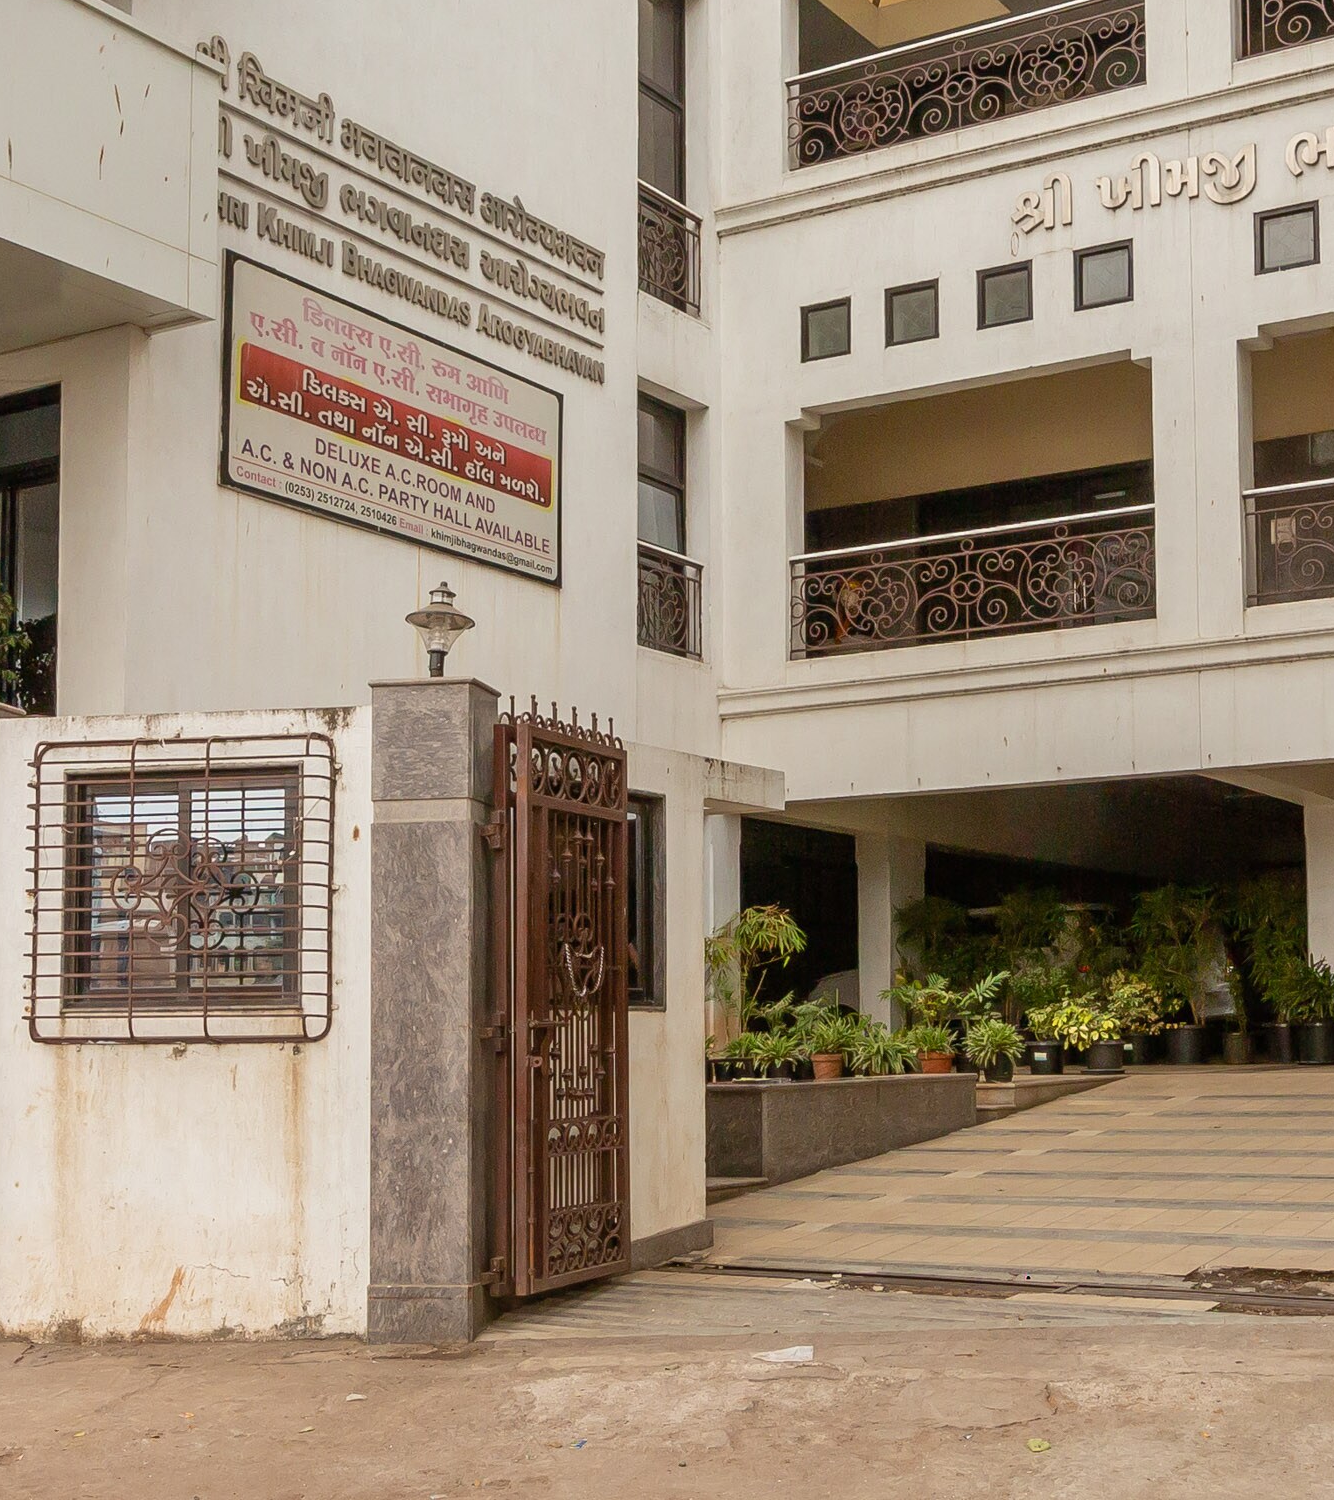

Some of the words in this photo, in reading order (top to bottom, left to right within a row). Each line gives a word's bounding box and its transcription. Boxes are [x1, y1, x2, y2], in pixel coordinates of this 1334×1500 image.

[218, 191, 250, 230] HRI
[237, 51, 335, 144] खिमजी
[340, 118, 476, 216] भगवानदास
[479, 192, 606, 280] आरोग्यभवन
[1011, 170, 1073, 234] શ્રી
[1095, 142, 1257, 210] ખીમજી
[243, 134, 329, 209] ખીમજી
[339, 184, 471, 270] ભગવાનદાસ
[478, 250, 606, 334] આરોગ્યભવન
[249, 311, 304, 350] ए.सी.
[310, 336, 325, 358] व
[330, 342, 368, 375] नॉन
[425, 383, 489, 426] सभागृह
[493, 410, 548, 446] उपलब्ध
[302, 296, 374, 349] डिलक्स
[466, 372, 510, 405] आणि
[301, 368, 367, 413] ડિલક્સ
[406, 413, 435, 439] સી.
[441, 428, 469, 452] રૂમો
[474, 440, 506, 465] અને
[317, 409, 356, 434] તથા
[404, 436, 459, 472] એ.સી.
[499, 473, 546, 503] મળશે.
[236, 465, 276, 488] Contact
[285, 481, 315, 502] (0253)
[317, 491, 358, 515] 2512724,
[360, 505, 398, 526] 2510426
[399, 518, 424, 535] Email
[431, 528, 553, 575] khimjibhagwandas@gmail.com
[241, 438, 277, 465] A.C.
[282, 452, 295, 470] &
[300, 457, 337, 485] NON
[341, 472, 374, 496] A.C.
[379, 484, 430, 514] PARTY
[433, 502, 472, 529] HALL
[475, 517, 551, 555] AVAILABLE
[315, 437, 381, 476] DELUXE
[465, 491, 496, 514] AND
